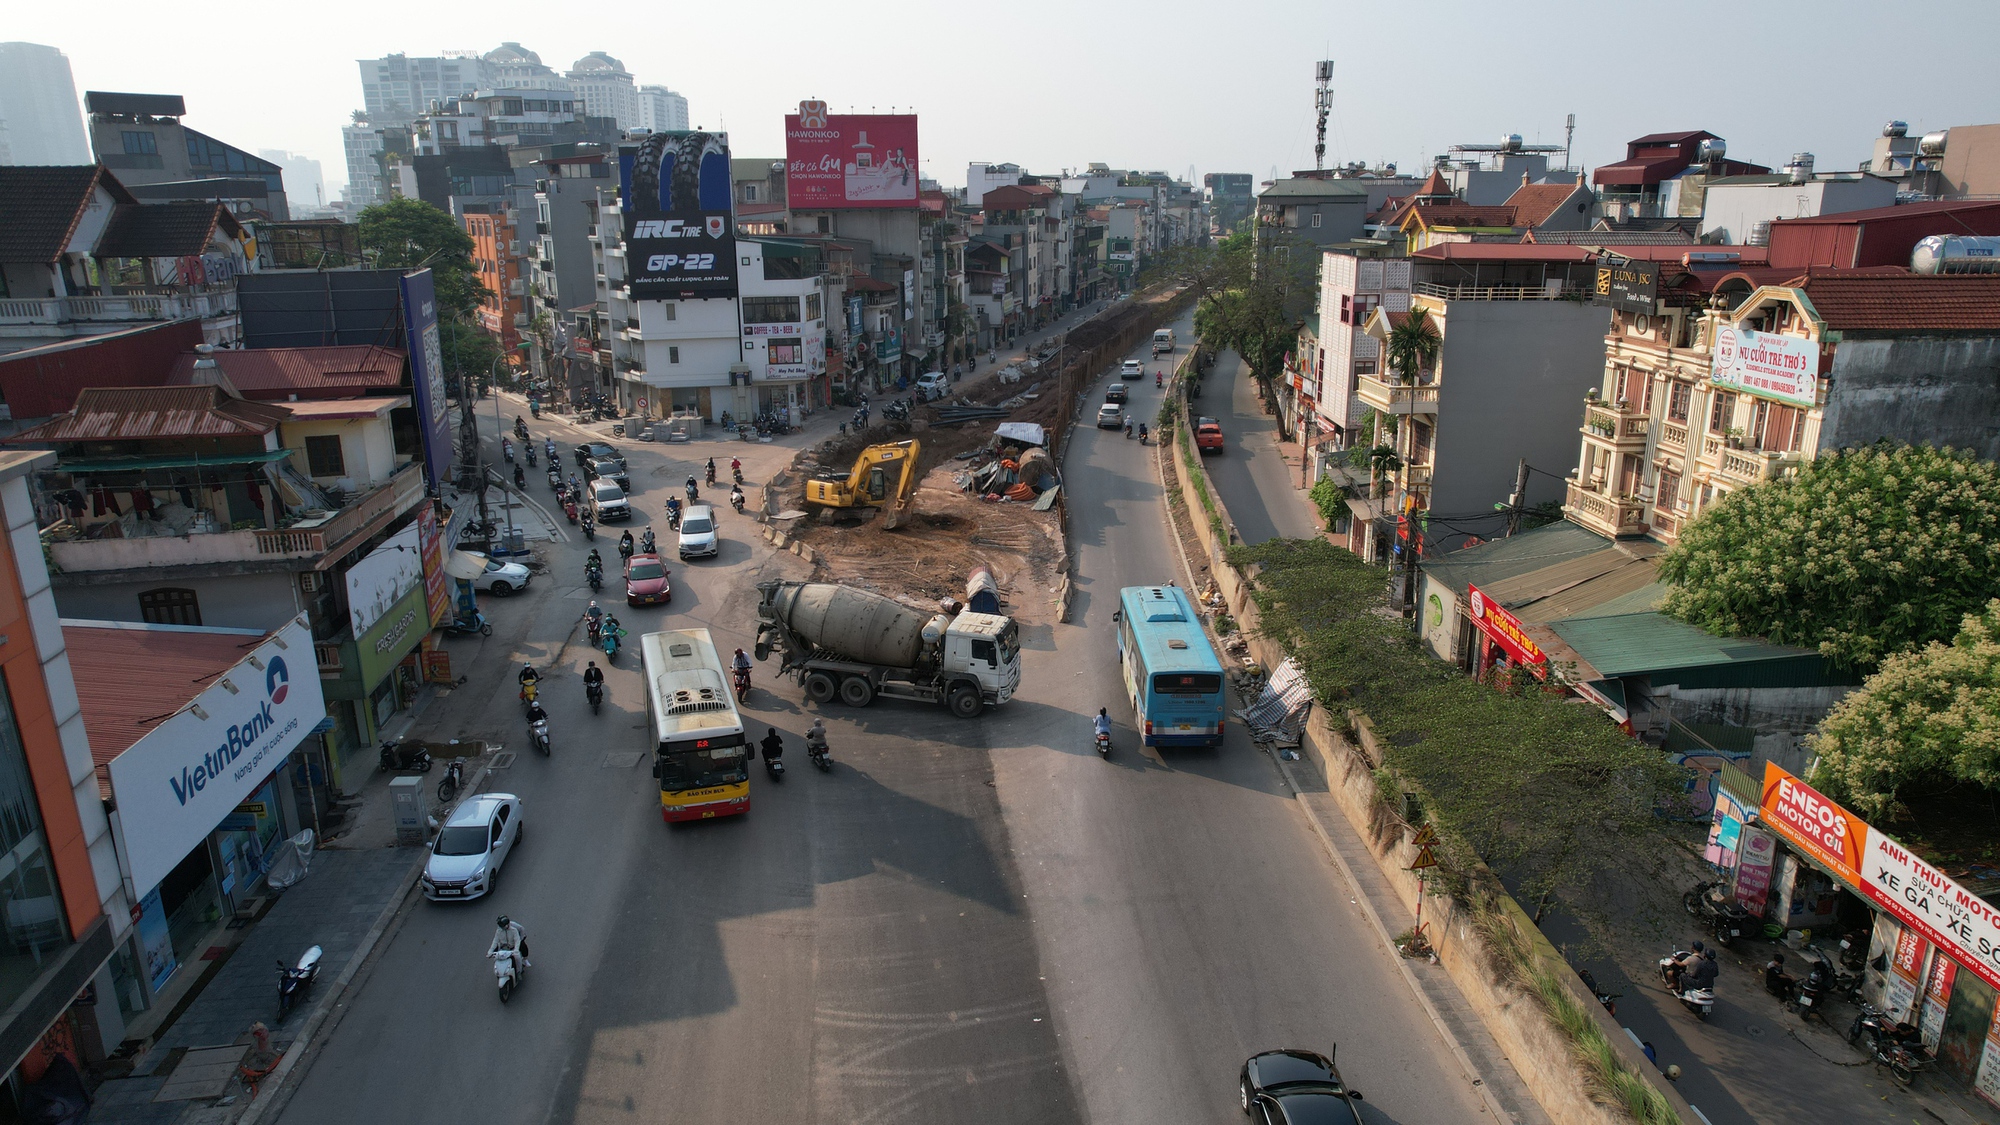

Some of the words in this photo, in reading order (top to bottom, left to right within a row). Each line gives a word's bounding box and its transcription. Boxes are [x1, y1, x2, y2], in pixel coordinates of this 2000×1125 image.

[788, 130, 840, 139] HAWONKOO
[681, 226, 702, 238] TIRE
[175, 252, 245, 286] HDBank
[646, 253, 716, 272] GP-22
[1614, 270, 1637, 282] LUNA
[1638, 273, 1651, 285] JSC
[753, 326, 768, 335] COFFEE
[771, 326, 779, 334] TEA
[783, 325, 793, 334] BEER
[1763, 367, 1776, 375] STEAM
[1776, 370, 1796, 380] ACADEMY
[1800, 355, 1807, 371] 3
[1779, 777, 1847, 837] ENEOS
[1777, 800, 1821, 840] MOTOR
[1823, 832, 1844, 856] OIL
[1879, 840, 1909, 867] ANH
[1877, 866, 1900, 893] XE
[1904, 886, 1930, 914] GA
[1946, 914, 1973, 943] XE
[1910, 876, 1935, 899] SỬA
[1937, 894, 1971, 924] CHỮA
[1902, 932, 1919, 972] ENEOS
[1932, 956, 1948, 997] ENEOS
